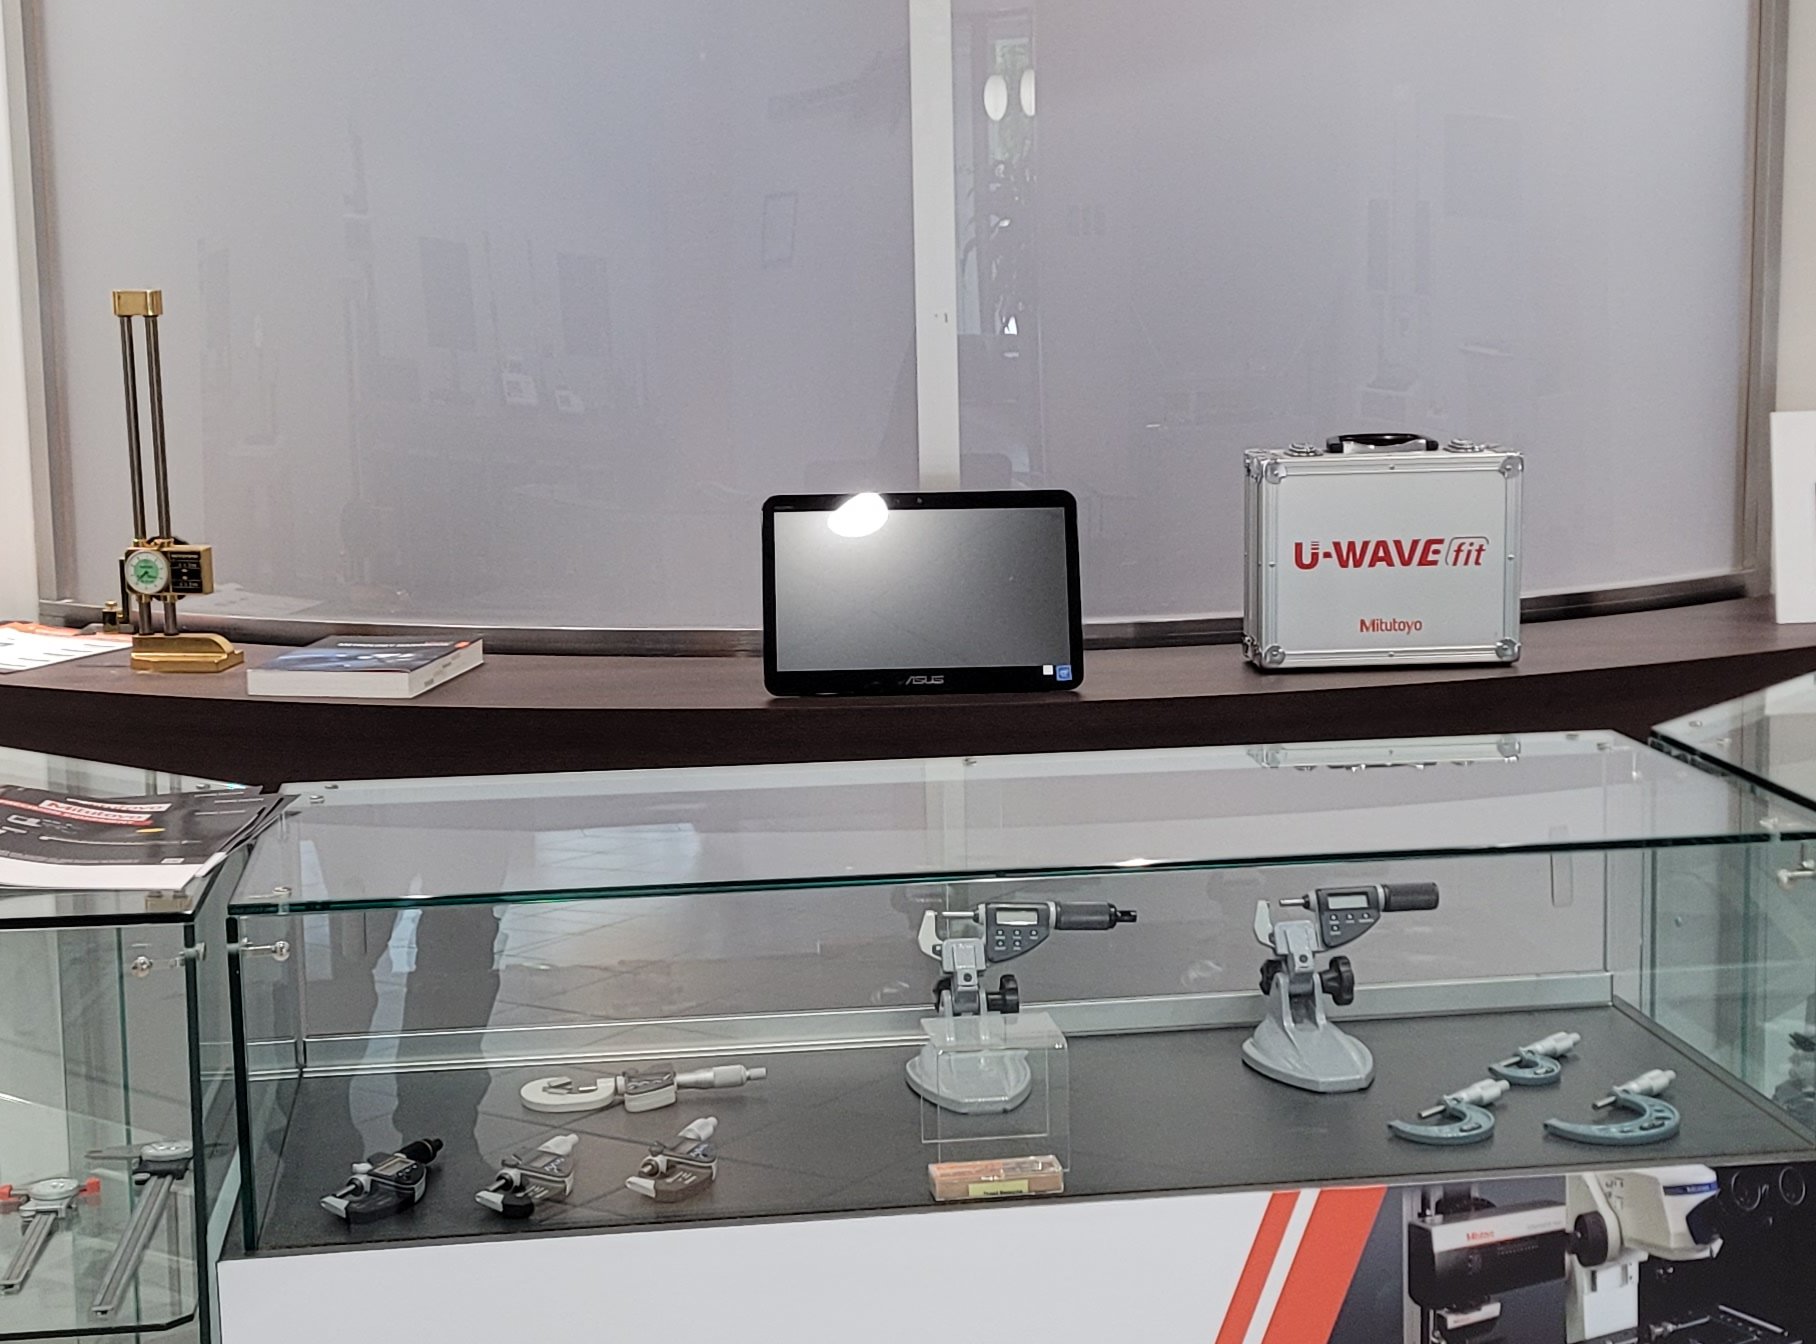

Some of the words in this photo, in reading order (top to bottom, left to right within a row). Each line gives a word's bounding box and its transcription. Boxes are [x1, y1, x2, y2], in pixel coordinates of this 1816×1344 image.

[1294, 538, 1445, 570] U-WAVE
[1452, 541, 1486, 567] fit
[1359, 618, 1423, 635] Mitutoyo
[905, 675, 945, 685] ASUS
